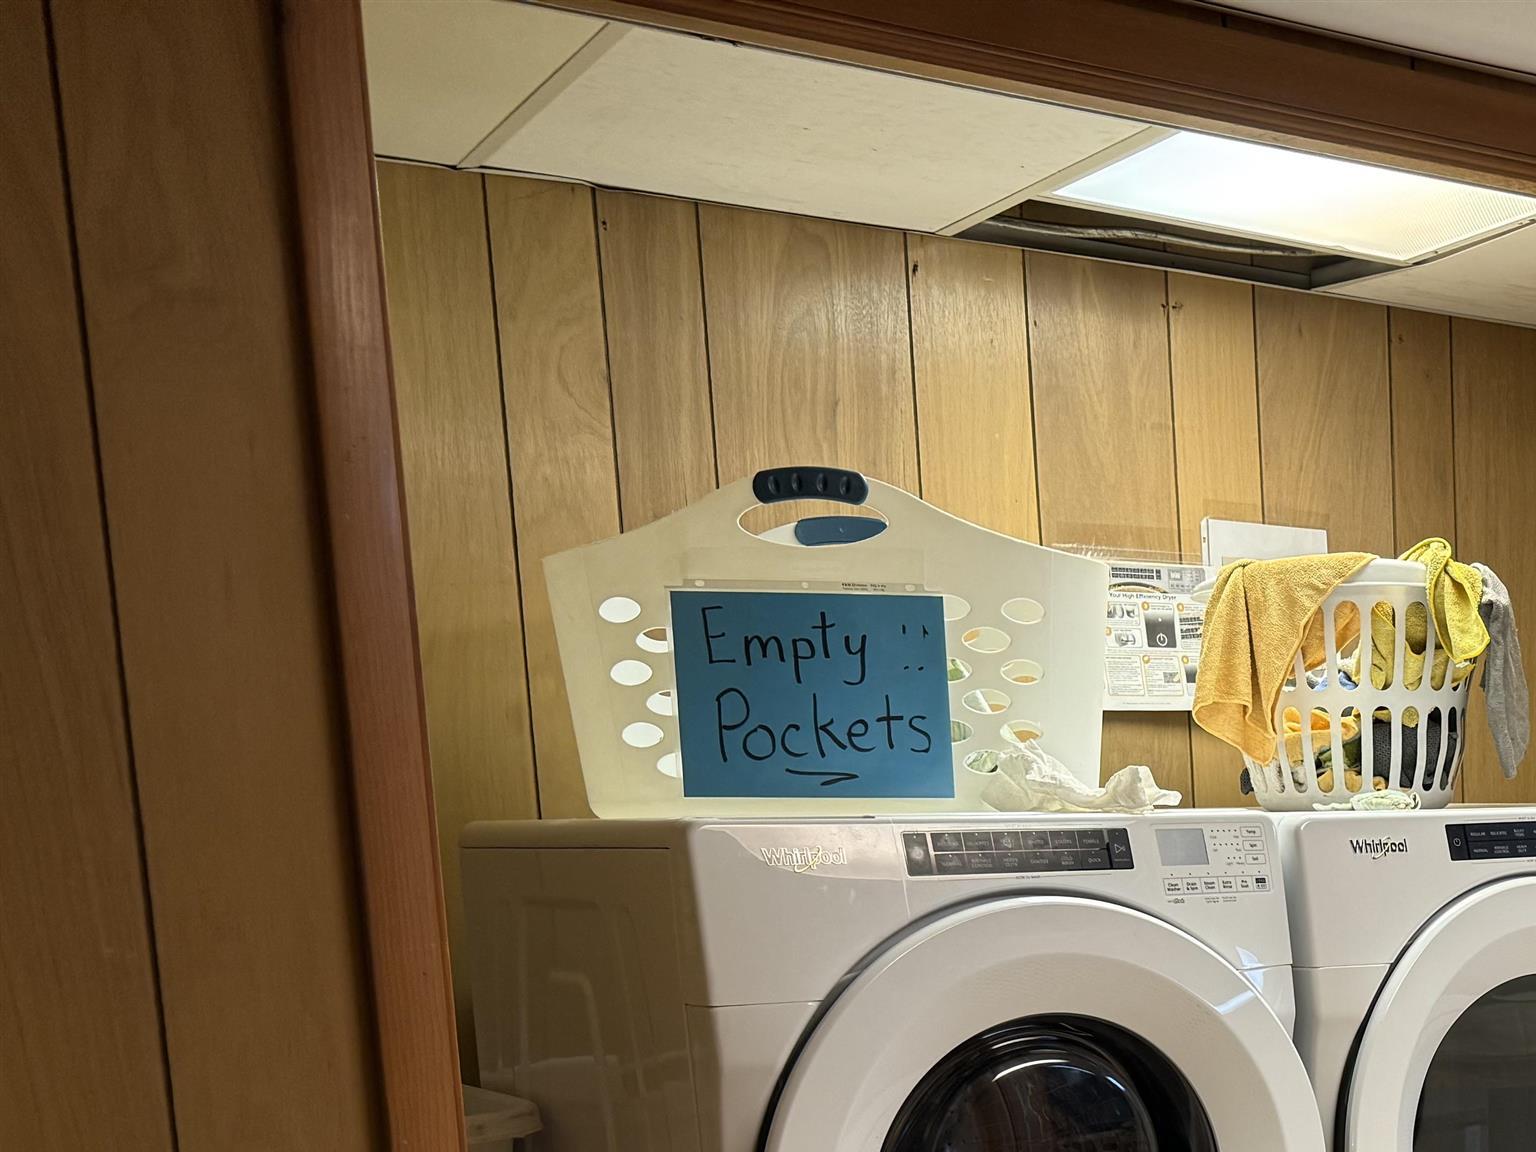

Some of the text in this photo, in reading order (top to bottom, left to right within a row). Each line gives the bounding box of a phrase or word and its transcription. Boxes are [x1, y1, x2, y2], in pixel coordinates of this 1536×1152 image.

[701, 605, 867, 685] Empty
[715, 687, 932, 763] Pockets
[760, 845, 847, 871] Whirlpool
[1349, 837, 1408, 858] Whirlpool
